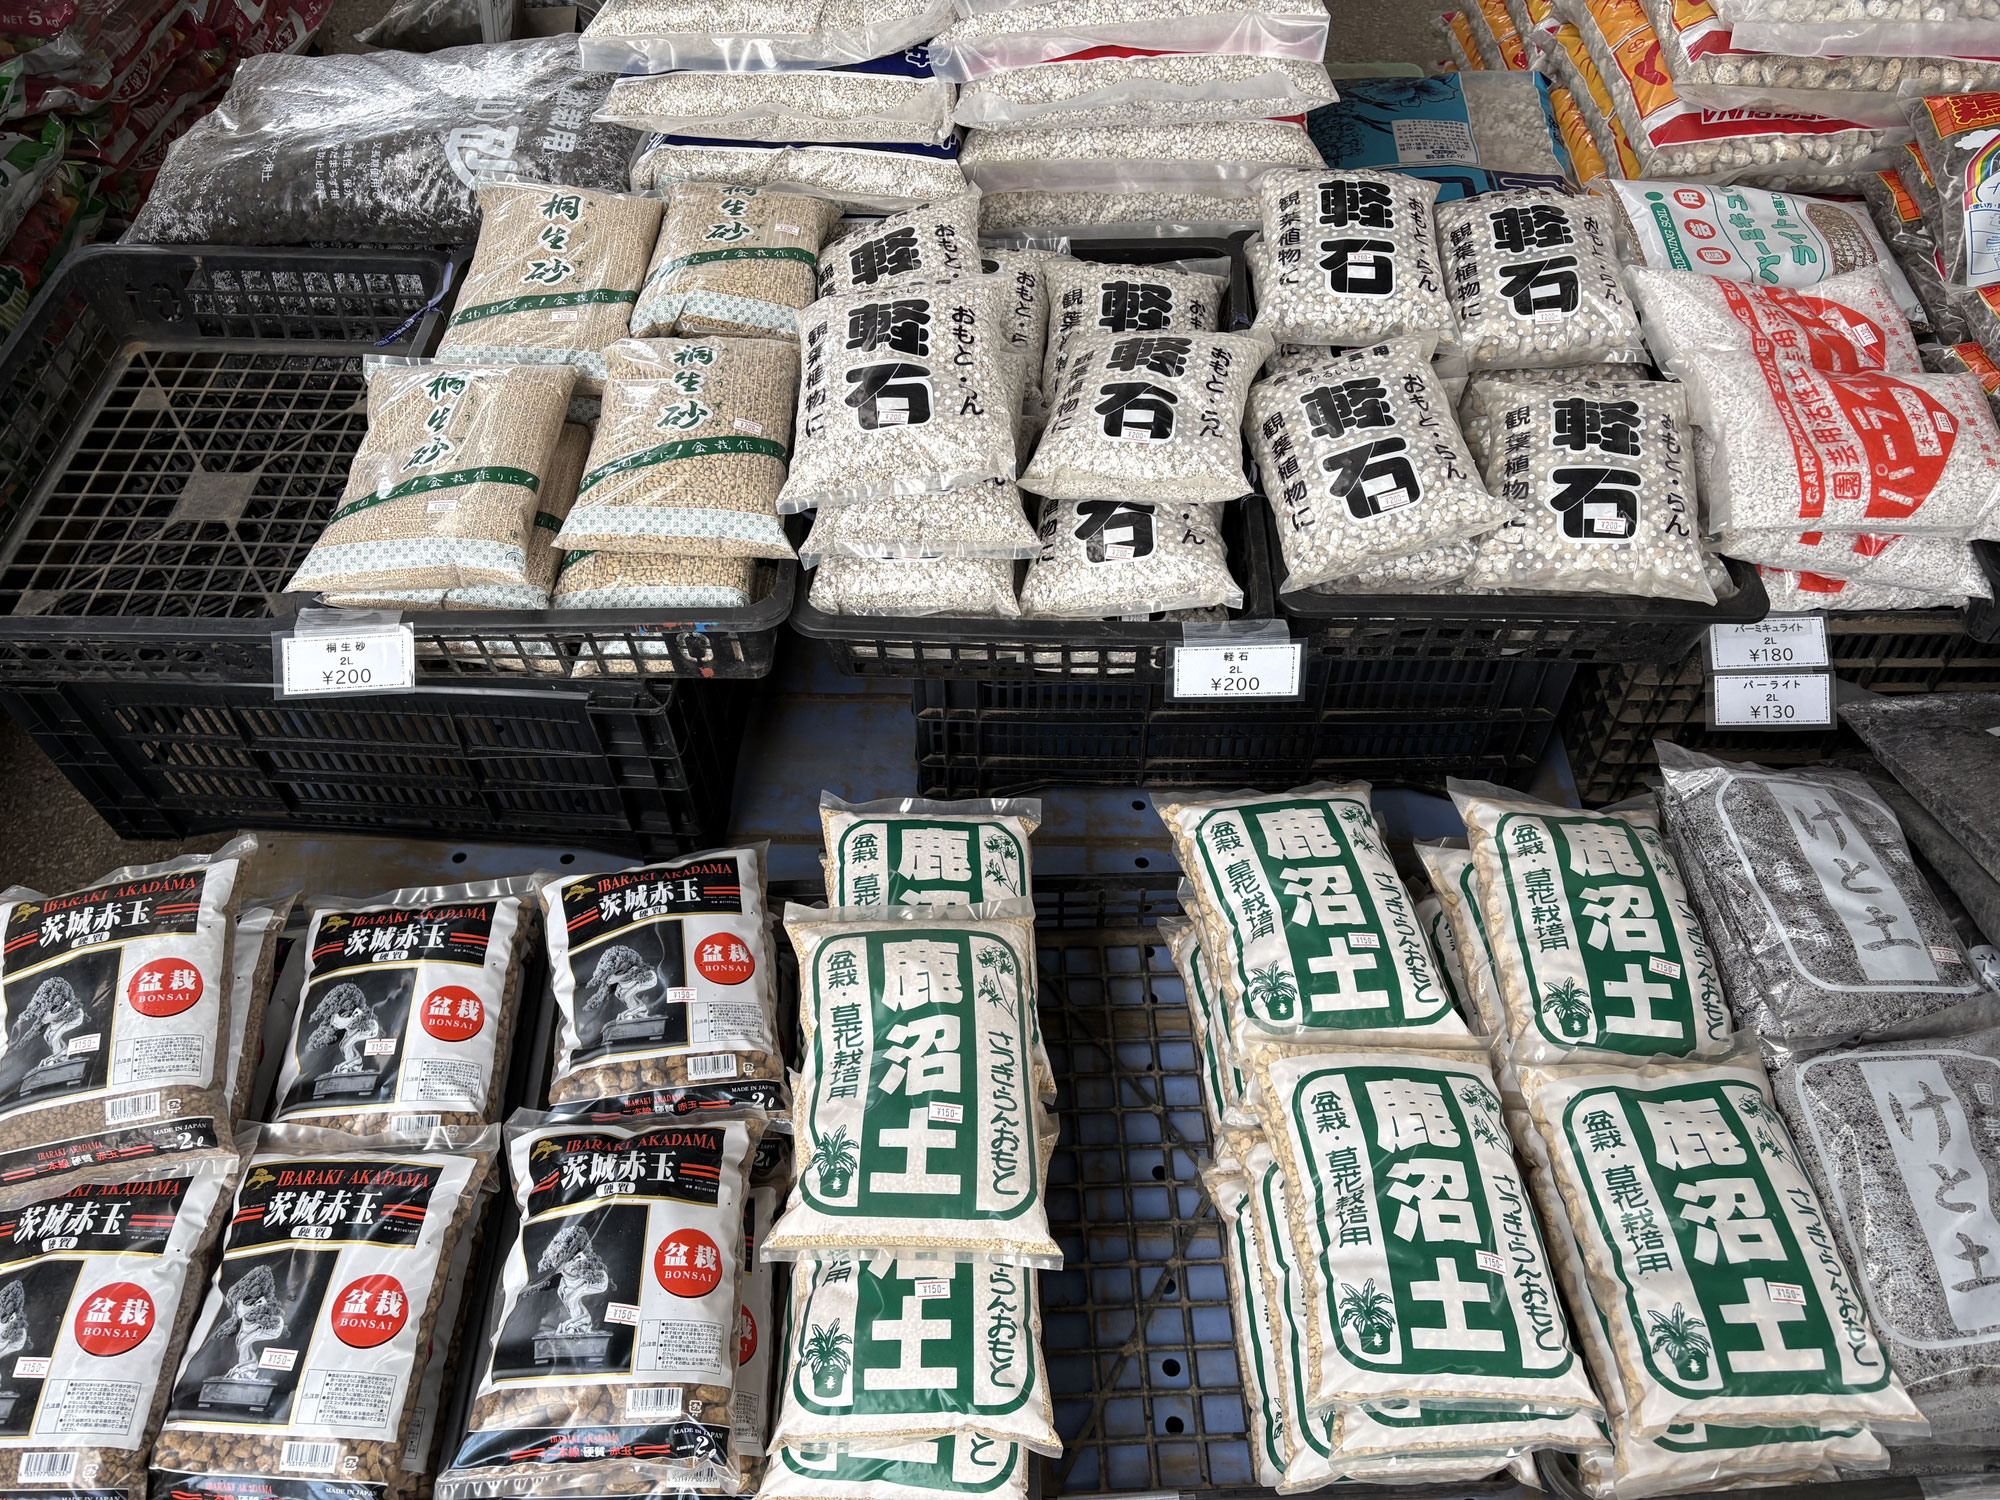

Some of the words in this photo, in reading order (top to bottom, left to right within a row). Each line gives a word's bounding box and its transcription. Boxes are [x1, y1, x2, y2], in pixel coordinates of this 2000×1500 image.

[3, 15, 23, 25] NET
[28, 10, 42, 26] 5
[523, 193, 581, 283] 桐生砂
[1279, 191, 1302, 286] 観葉植物に
[1320, 180, 1395, 294] 軽石
[1450, 222, 1482, 320] 観葉植物に
[1490, 205, 1578, 316] 軽石
[845, 300, 931, 426] 軽石
[658, 345, 712, 429] 桐生砂
[1095, 337, 1192, 439] 軽石
[403, 371, 466, 471] 桐生砂
[882, 411, 907, 423] ¥200-
[1402, 373, 1467, 480] おもと・らん
[1301, 377, 1420, 518] 軽石
[1785, 397, 1821, 504] GARDENING
[1261, 411, 1314, 531] 観葉植物に
[1503, 406, 1531, 529] 観葉植物に
[1551, 398, 1642, 538] 軽石
[1661, 414, 1690, 537] おもと・らん
[1601, 521, 1624, 532] ¥200-
[326, 642, 366, 653] 桐生砂
[1764, 637, 1777, 645] 2L
[340, 657, 354, 665] 2L
[1223, 651, 1249, 662] 軽石
[1749, 648, 1793, 662] ¥180
[322, 668, 372, 685] ¥200
[1229, 666, 1243, 674] 2L
[1211, 677, 1260, 691] ¥200
[1743, 680, 1801, 690] パーライト
[1766, 694, 1779, 702] 2L
[1751, 705, 1795, 719] ¥130
[598, 872, 656, 894] IBARAKI
[661, 863, 733, 880] AKADAMA
[1210, 821, 1275, 944] 盆栽・草花栽培用
[1511, 824, 1570, 953] 盆栽・草花栽培用
[42, 890, 108, 914] IBARAKI
[114, 876, 196, 898] AKADAMA
[599, 878, 701, 922] 茨城赤玉
[352, 912, 409, 928] IBARAKI
[413, 907, 487, 922] AKADAMA
[1256, 808, 1390, 1013] 鹿沼土
[38, 898, 153, 948] 茨城赤玉
[1559, 822, 1684, 1039] 鹿沼土
[344, 923, 448, 957] 茨城赤玉
[1355, 937, 1377, 945] ¥150-
[1373, 871, 1439, 1004] さつき・らん・おもと
[701, 943, 750, 964] 盆栽
[705, 963, 748, 973] BONSAI
[1655, 962, 1677, 973] ¥150-
[1676, 898, 1724, 1042] さつき・らん・おもと
[137, 969, 197, 992] 盆栽
[138, 993, 190, 1003] BONSAI
[673, 991, 695, 999] ¥150-
[428, 996, 479, 1022] 盆栽
[429, 1018, 473, 1031] BONSAI
[827, 951, 864, 1101] 盆栽・草花栽培用
[73, 1038, 97, 1050] ¥150-
[372, 1043, 392, 1052] ¥150-
[870, 939, 963, 1194] 鹿沼土
[677, 1101, 698, 1112] 赤玉
[936, 1108, 959, 1117] ¥150-
[988, 1030, 1020, 1195] さつき・らん・おもと
[153, 1126, 174, 1136] MADE
[184, 1122, 207, 1130] JAPAN
[38, 1149, 67, 1161] IBARAKI
[69, 1141, 103, 1154] AKADAMA
[565, 1140, 631, 1153] IBARAKI
[637, 1133, 716, 1150] AKADAMA
[71, 1154, 94, 1167] 硬質
[96, 1149, 119, 1161] 赤玉
[277, 1170, 345, 1187] IBARAKI
[348, 1170, 428, 1188] AKADAMA
[560, 1150, 677, 1190] 茨城赤玉
[1311, 1090, 1373, 1249] 盆栽・草花栽培用
[97, 1181, 179, 1197] AKADAMA
[1582, 1110, 1673, 1275] 盆栽・草花栽培用
[264, 1191, 383, 1227] 茨城赤玉
[1365, 1079, 1505, 1351] 鹿沼土
[14, 1200, 131, 1244] 茨城赤玉
[1637, 1098, 1826, 1373] 鹿沼土
[663, 1242, 717, 1271] 盆栽
[1483, 1257, 1503, 1270] ¥150-
[1492, 1174, 1562, 1351] さつき・らん・おもと
[664, 1269, 713, 1283] BONSAI
[1786, 1187, 1878, 1367] さつき・らん・おもと
[923, 1284, 946, 1295] ¥150-
[1776, 1287, 1801, 1298] ¥150-
[84, 1297, 149, 1326] 盆栽
[341, 1289, 403, 1317] 盆栽
[613, 1308, 636, 1320] ¥150-
[83, 1326, 138, 1338] BONSAI
[340, 1318, 392, 1331] BONSAI
[23, 1363, 45, 1373] ¥150-
[268, 1354, 291, 1364] ¥150-
[674, 1427, 694, 1435] MADE
[704, 1431, 724, 1439] JAPAN
[583, 1446, 605, 1458] 硬質
[609, 1446, 632, 1456] 赤玉
[347, 1488, 354, 1496] IN
